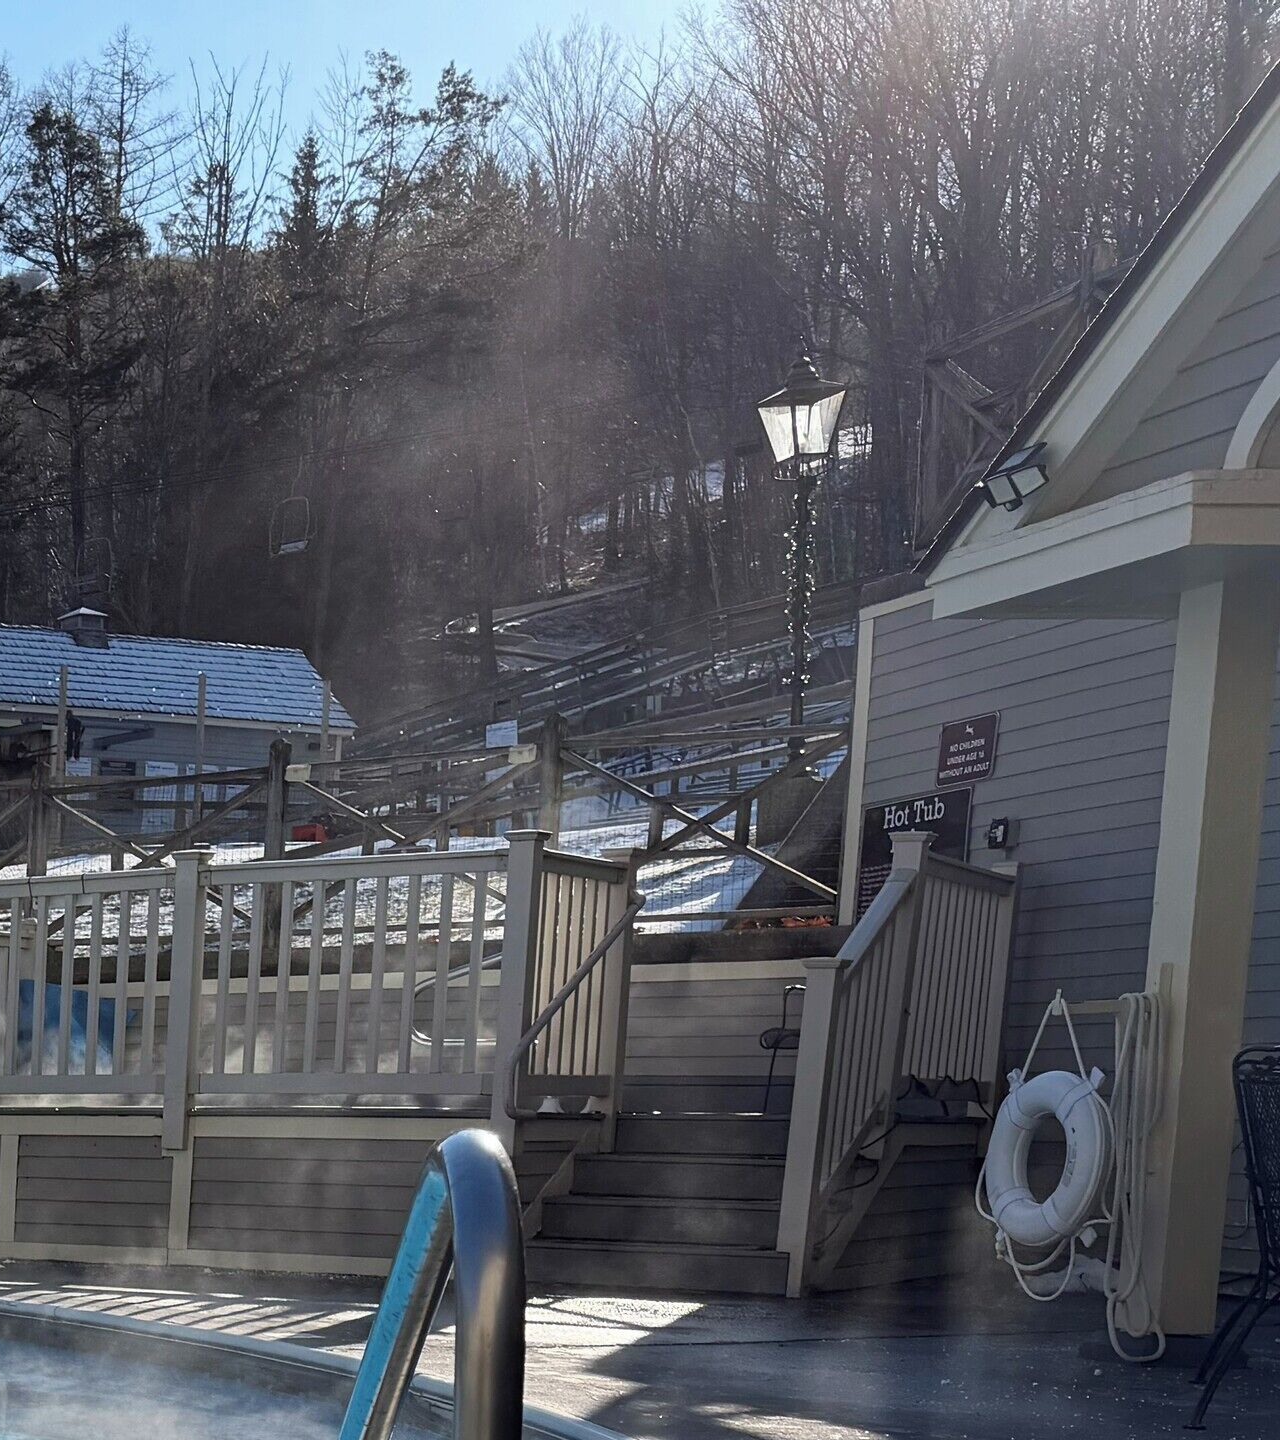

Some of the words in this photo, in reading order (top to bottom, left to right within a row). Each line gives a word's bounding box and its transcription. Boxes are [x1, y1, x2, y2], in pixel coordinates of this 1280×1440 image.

[949, 743, 958, 752] NO
[959, 738, 985, 750] CHILDREN
[947, 754, 965, 765] UNDER
[966, 751, 977, 761] AGE
[964, 765, 972, 774] AN
[973, 761, 989, 772] ADULT
[883, 805, 909, 829] Hot
[913, 797, 945, 823] Tub
